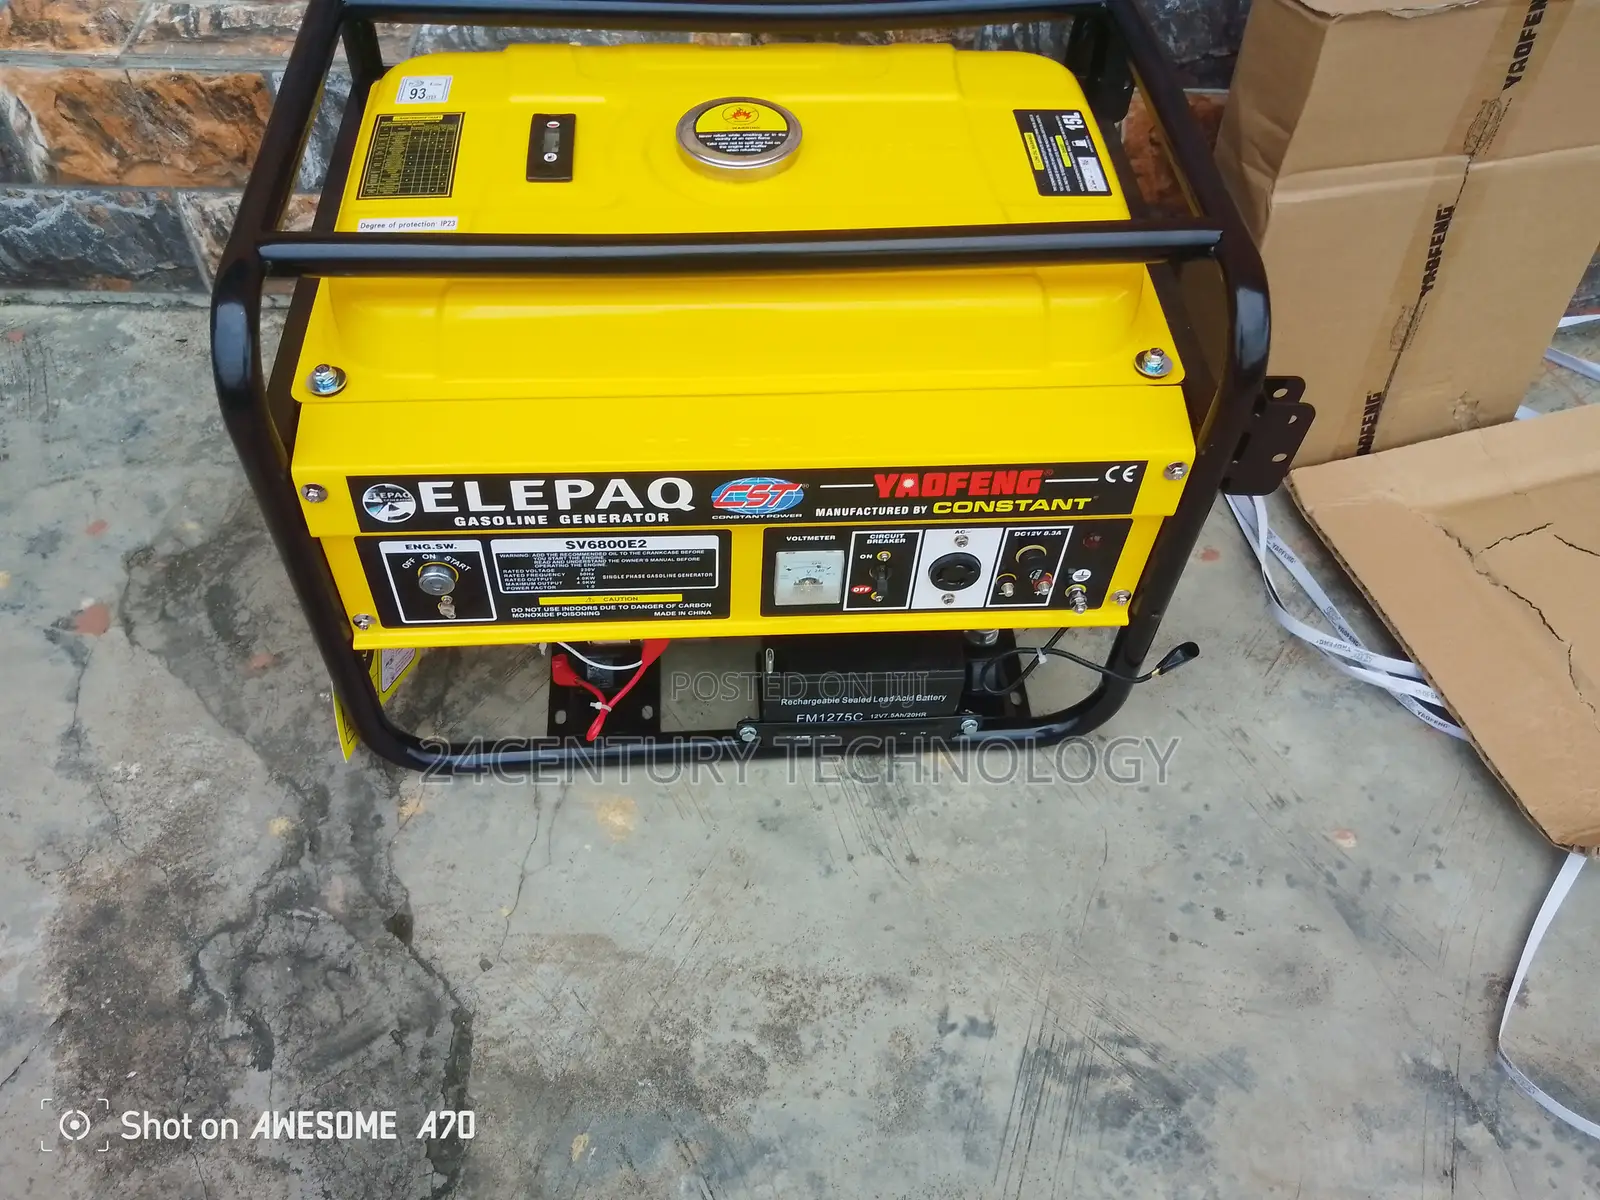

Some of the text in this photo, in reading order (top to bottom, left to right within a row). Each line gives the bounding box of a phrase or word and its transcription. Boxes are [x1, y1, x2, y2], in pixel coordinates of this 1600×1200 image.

[409, 87, 426, 99] 93
[1061, 112, 1085, 130] 15L
[360, 222, 385, 230] Degree
[1419, 205, 1455, 298] YAOFENG
[1105, 465, 1138, 484] CE
[874, 469, 1045, 498] YAOFENG
[417, 477, 696, 512] ELEPAQ
[713, 483, 802, 508] CST
[815, 498, 1093, 517] MANUFACTURED BY CONSTANT
[454, 512, 670, 527] GASOLINE GENERATOR
[565, 539, 647, 551] SV6800E2
[402, 557, 416, 569] OFF
[444, 555, 472, 572] START
[781, 698, 840, 706] Rechargeable
[841, 696, 871, 704] Sealed
[873, 695, 894, 703] Lead
[916, 694, 947, 703] Battery
[796, 712, 864, 723] FM1275C
